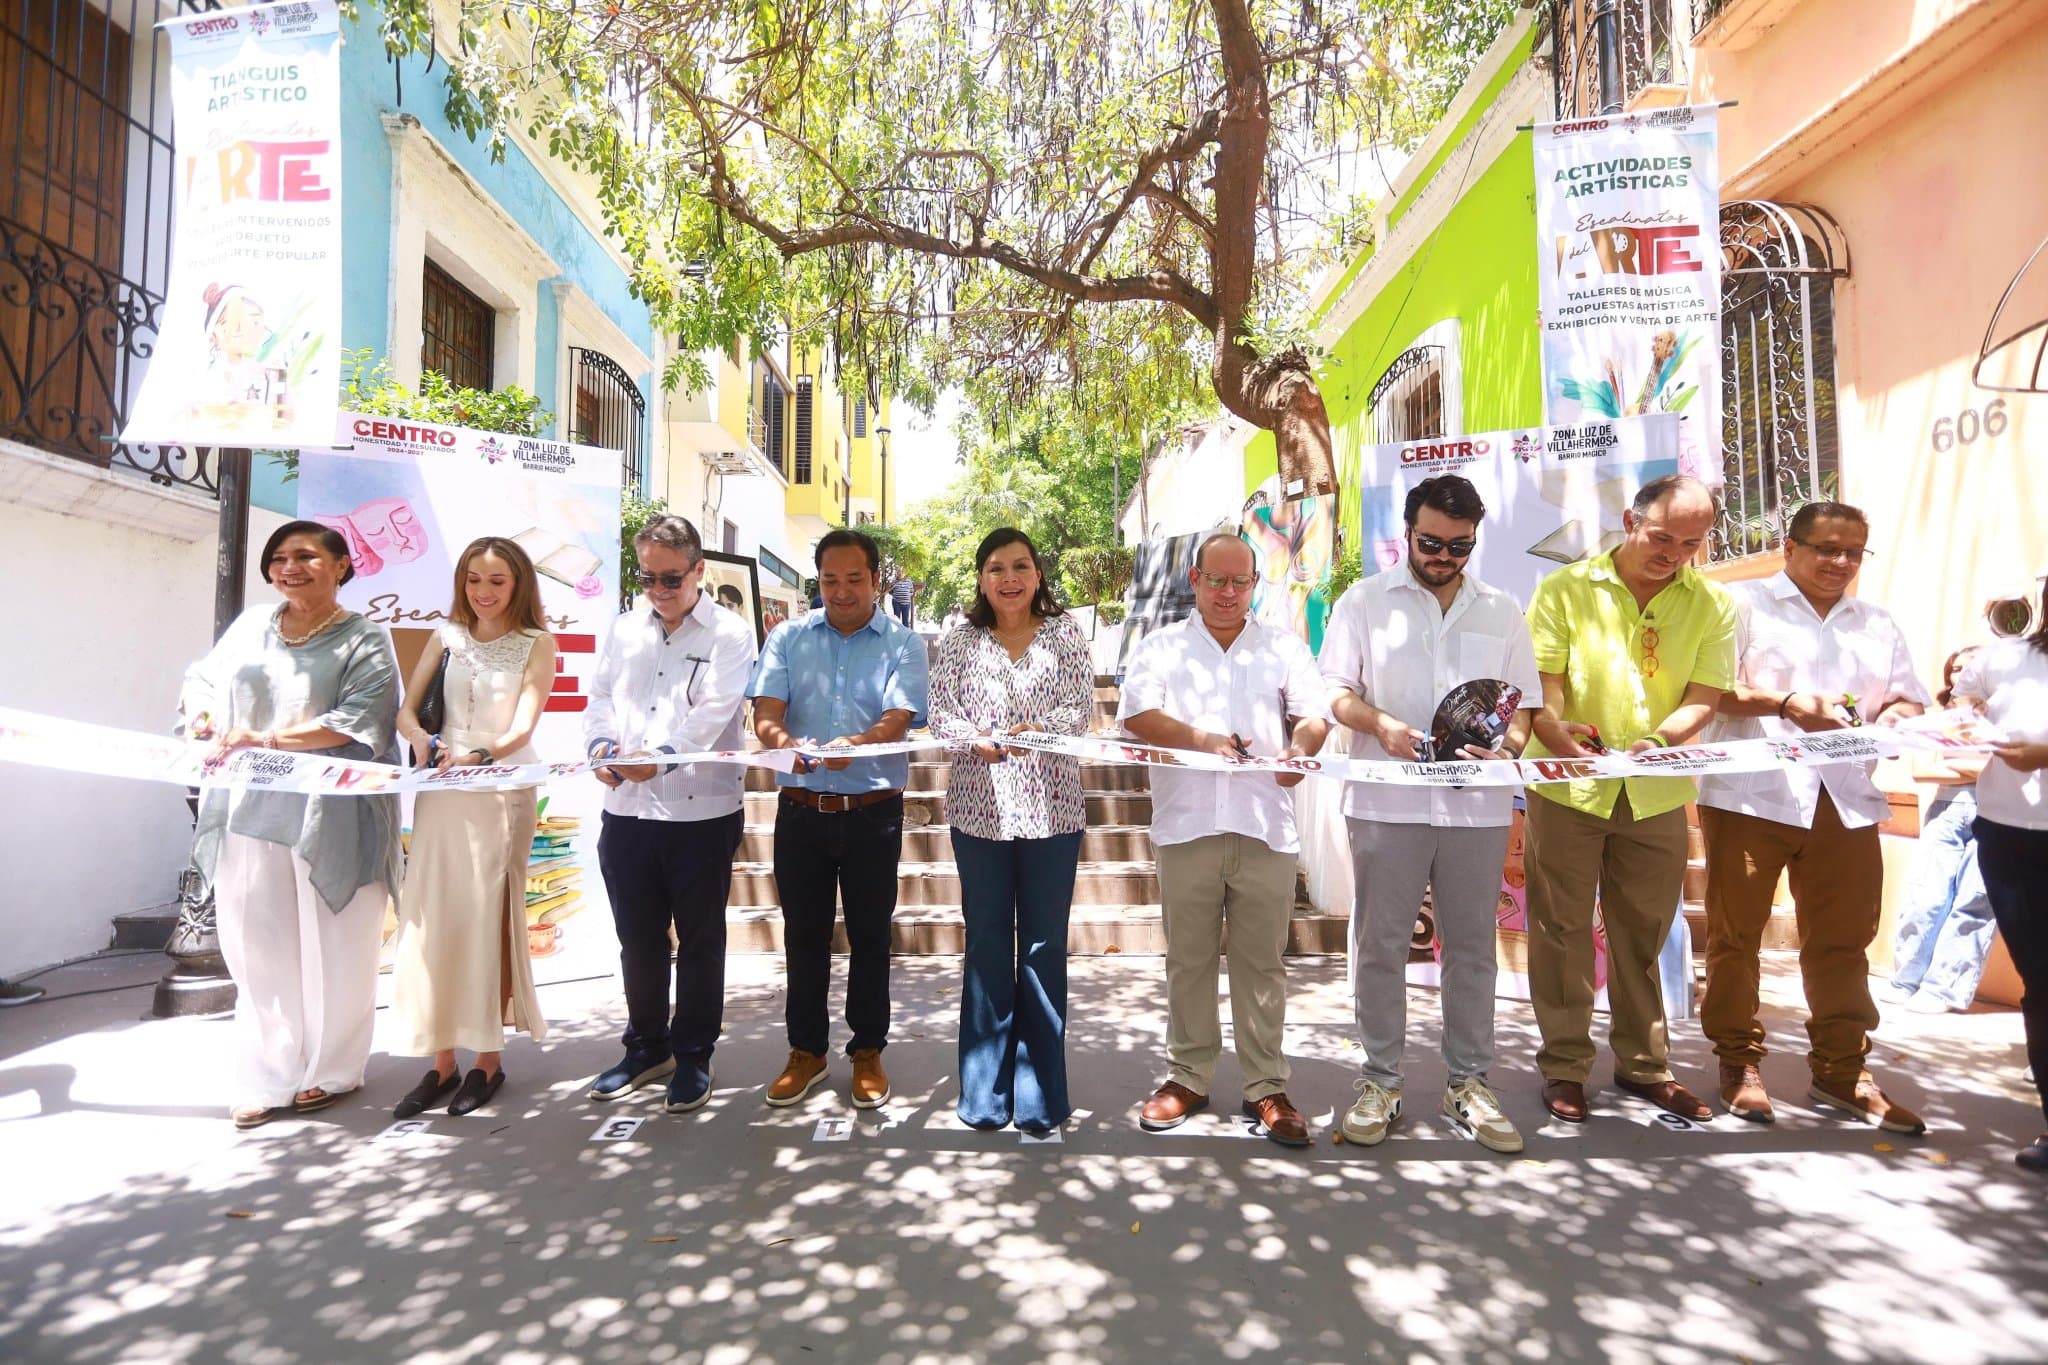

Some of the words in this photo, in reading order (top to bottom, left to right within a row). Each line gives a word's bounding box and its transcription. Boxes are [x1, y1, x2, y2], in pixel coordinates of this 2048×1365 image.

[185, 16, 239, 36] CENTRO
[209, 64, 300, 90] TIANGUIS
[208, 86, 308, 112] ARTSTICO
[1552, 120, 1609, 135] CENTRO
[1554, 156, 1692, 182] ACTIVIDADES
[1564, 173, 1688, 198] ARTÍSTICAS
[235, 215, 332, 228] NTERVENIDOS
[1575, 209, 1688, 232] Escalinatas
[236, 231, 291, 244] OBJETO
[265, 250, 327, 261] POPULAR
[1568, 240, 1591, 260] del
[1568, 286, 1627, 301] TALLERES
[1630, 286, 1642, 296] DE
[1644, 285, 1692, 297] MÚSICA
[1558, 300, 1634, 316] PROPUESTAS
[1636, 299, 1705, 312] ARTÍSTICAS
[1548, 314, 1618, 331] EXHIBICIÓN
[1620, 315, 1626, 323] Y
[1630, 316, 1661, 326] VENTA
[1665, 315, 1680, 324] DE
[1685, 312, 1718, 322] ARTE
[353, 420, 456, 447] CENTRO
[1552, 428, 1576, 441] ZONA
[1580, 426, 1596, 438] LUZ
[1599, 424, 1612, 436] DE
[1931, 398, 2008, 453] 606
[353, 436, 400, 447] HONESTIDAD
[410, 444, 456, 454] RESULTADOS
[518, 440, 540, 451] ZONA
[542, 443, 557, 454] LUZ
[560, 445, 570, 455] DE
[1400, 440, 1490, 463] CENTRO
[1547, 435, 1618, 452] VILLAHERMOSA
[512, 449, 576, 466] VILLAHERMOSA
[1558, 452, 1580, 460] BARRIO
[1400, 460, 1440, 470] HONESTIDAD
[230, 760, 294, 776] VILAHERMOSA
